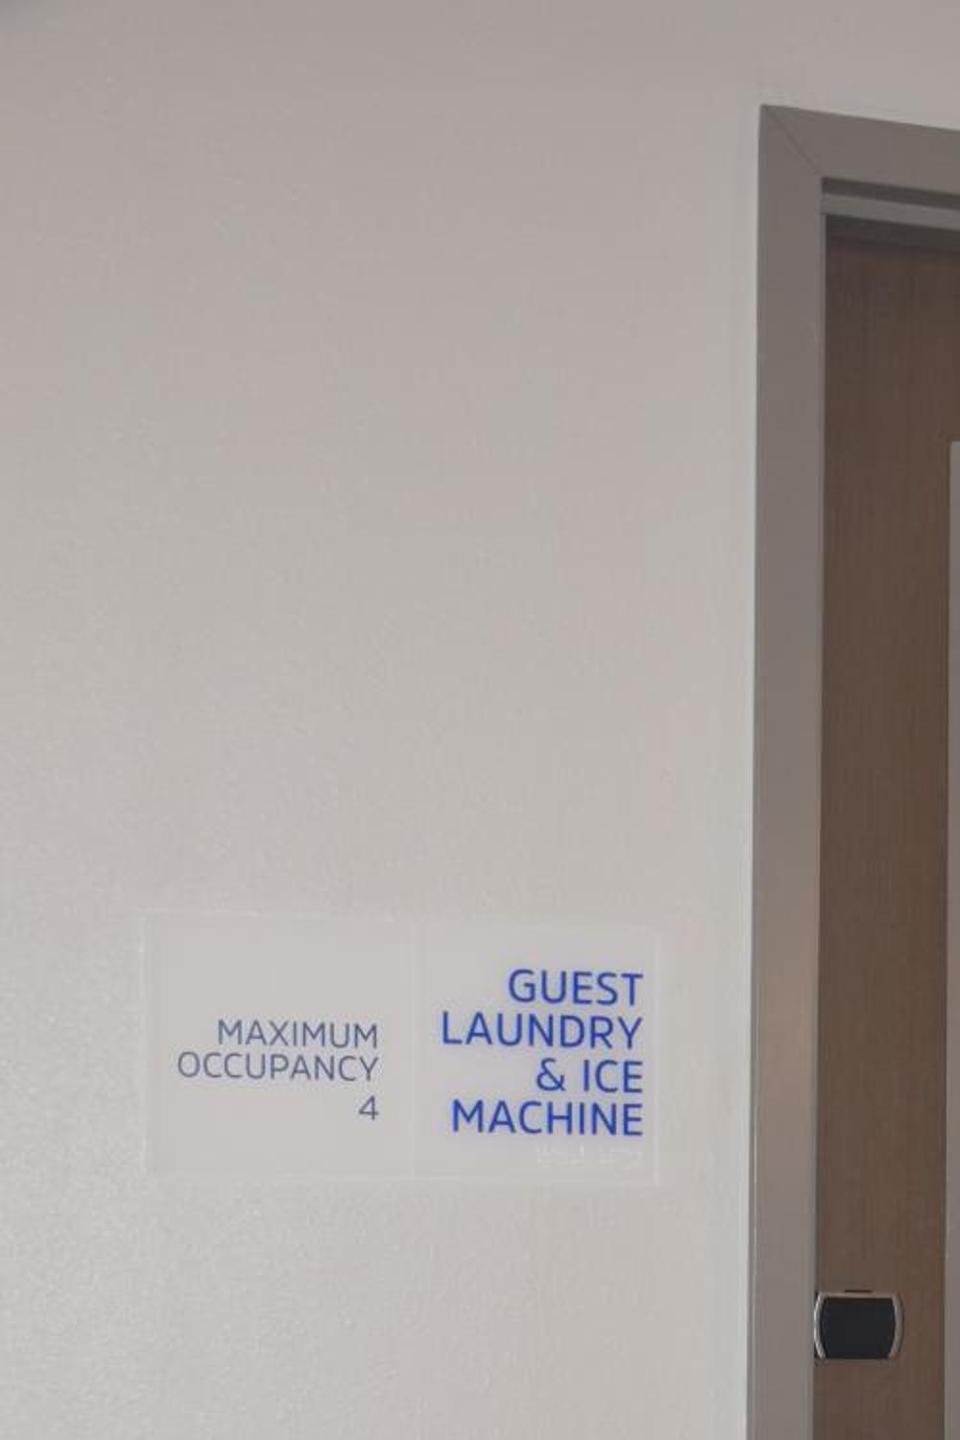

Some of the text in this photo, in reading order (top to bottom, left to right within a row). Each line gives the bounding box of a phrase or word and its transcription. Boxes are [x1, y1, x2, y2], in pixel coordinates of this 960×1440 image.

[508, 967, 645, 1007] GUEST
[217, 1018, 378, 1050] MAXIMUM
[441, 1009, 644, 1051] LAUNDRY
[176, 1050, 380, 1083] OCCUPANCY
[535, 1056, 644, 1095] & ICE
[358, 1094, 380, 1121] 4
[451, 1097, 644, 1138] MACHINE
